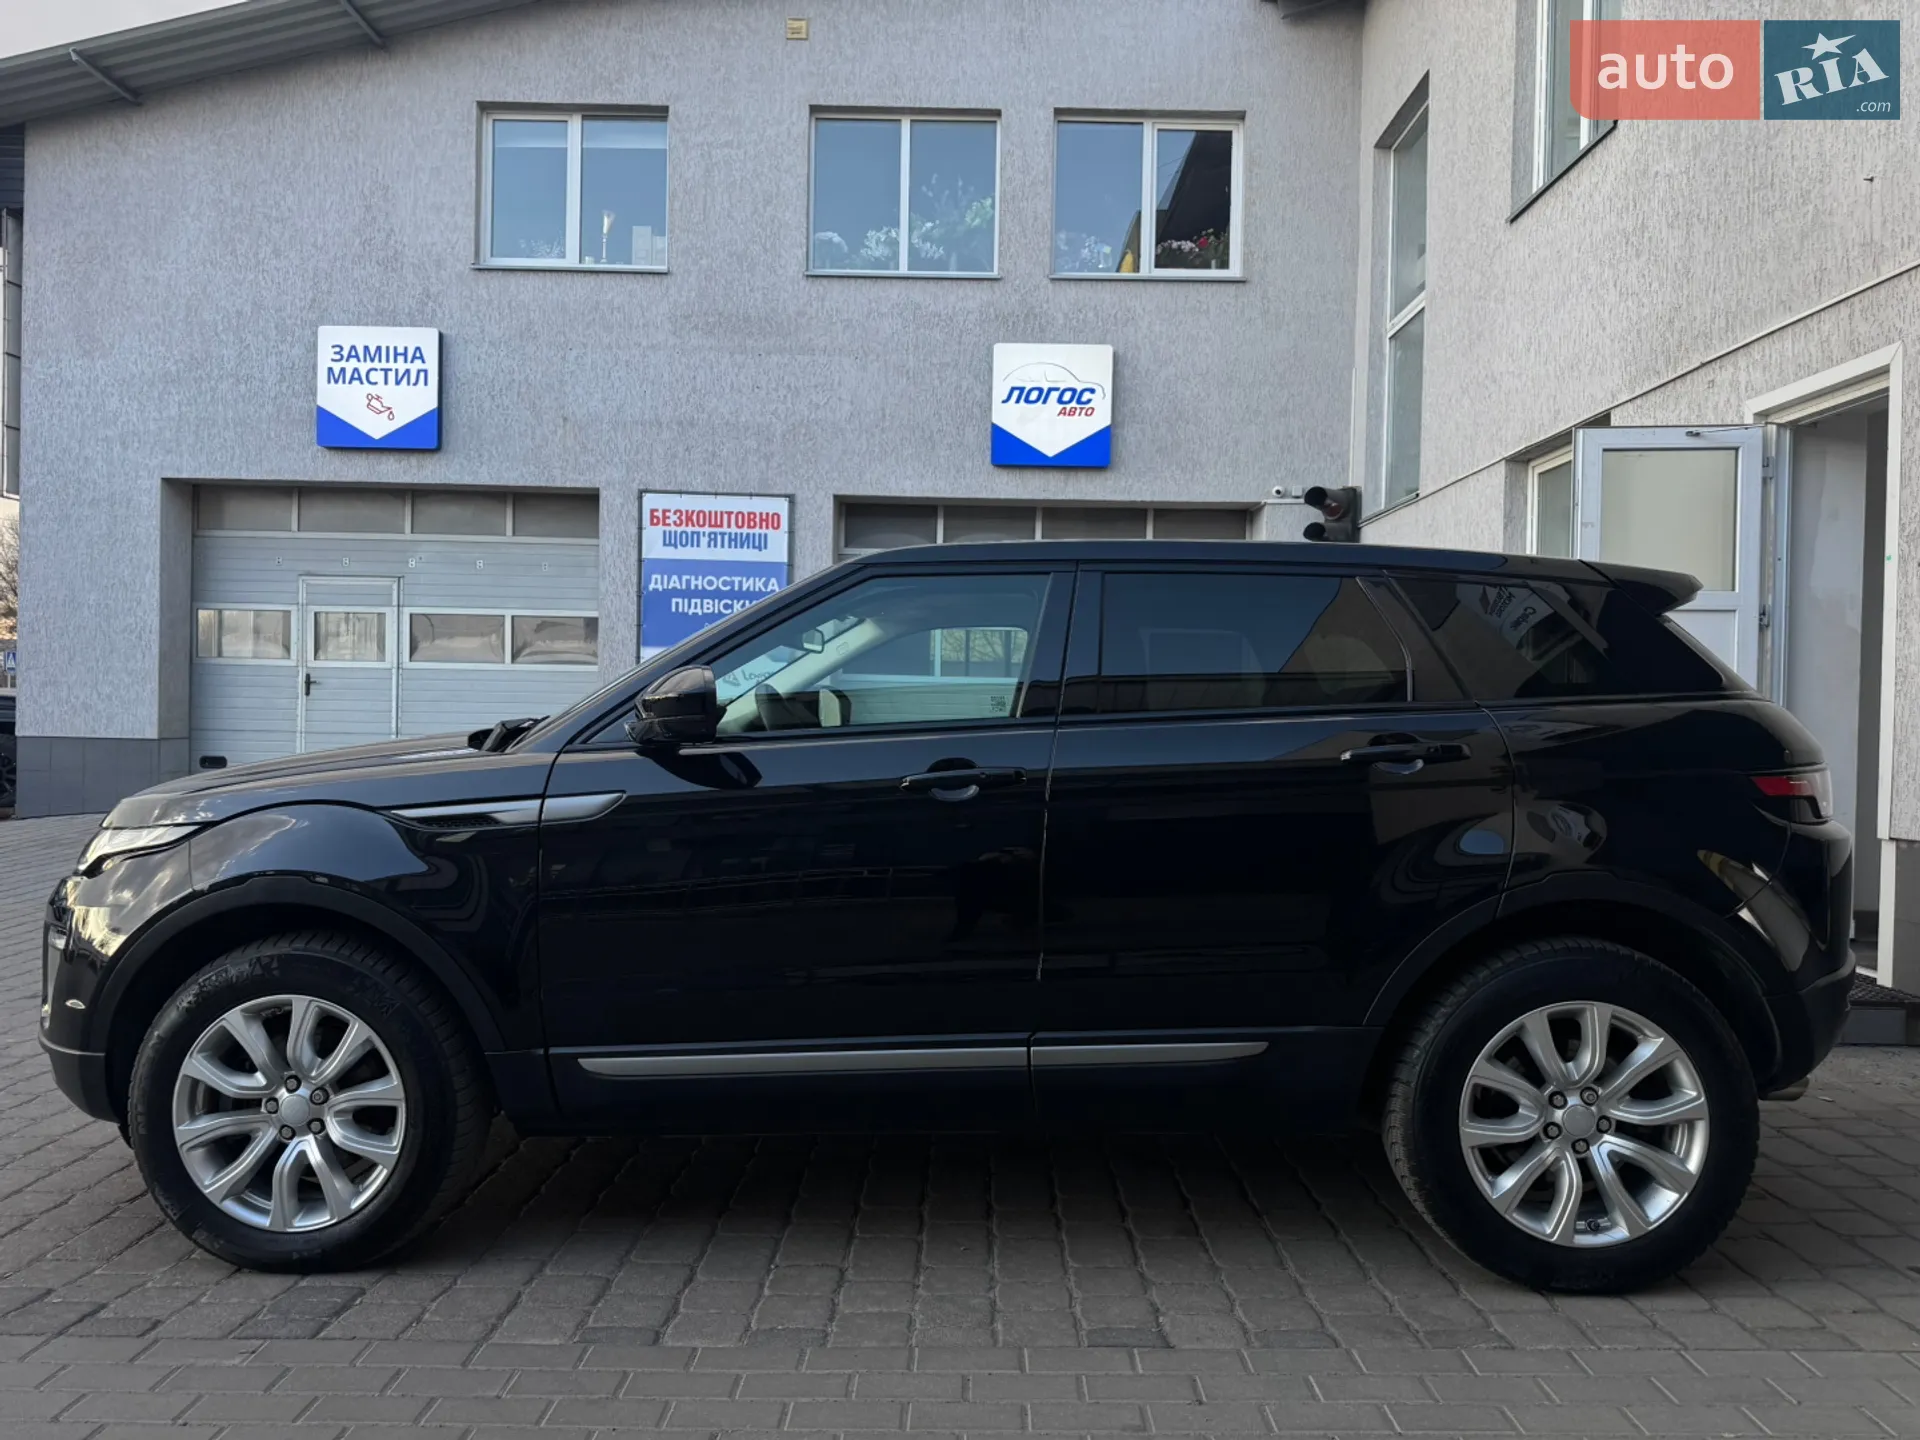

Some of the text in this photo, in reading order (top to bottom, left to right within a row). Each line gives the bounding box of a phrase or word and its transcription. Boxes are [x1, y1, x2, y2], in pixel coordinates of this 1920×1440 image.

[330, 344, 426, 364] ЗАМІНА
[327, 366, 428, 387] МАСТИЛ
[1001, 386, 1096, 405] ЛОГОС
[1057, 406, 1095, 417] АВТО
[649, 508, 781, 530] БЕЗКОШТОВНО
[662, 529, 768, 551] ЩОП'ЯТНИЦІ
[648, 574, 779, 592] ДІАГНОСТИКА
